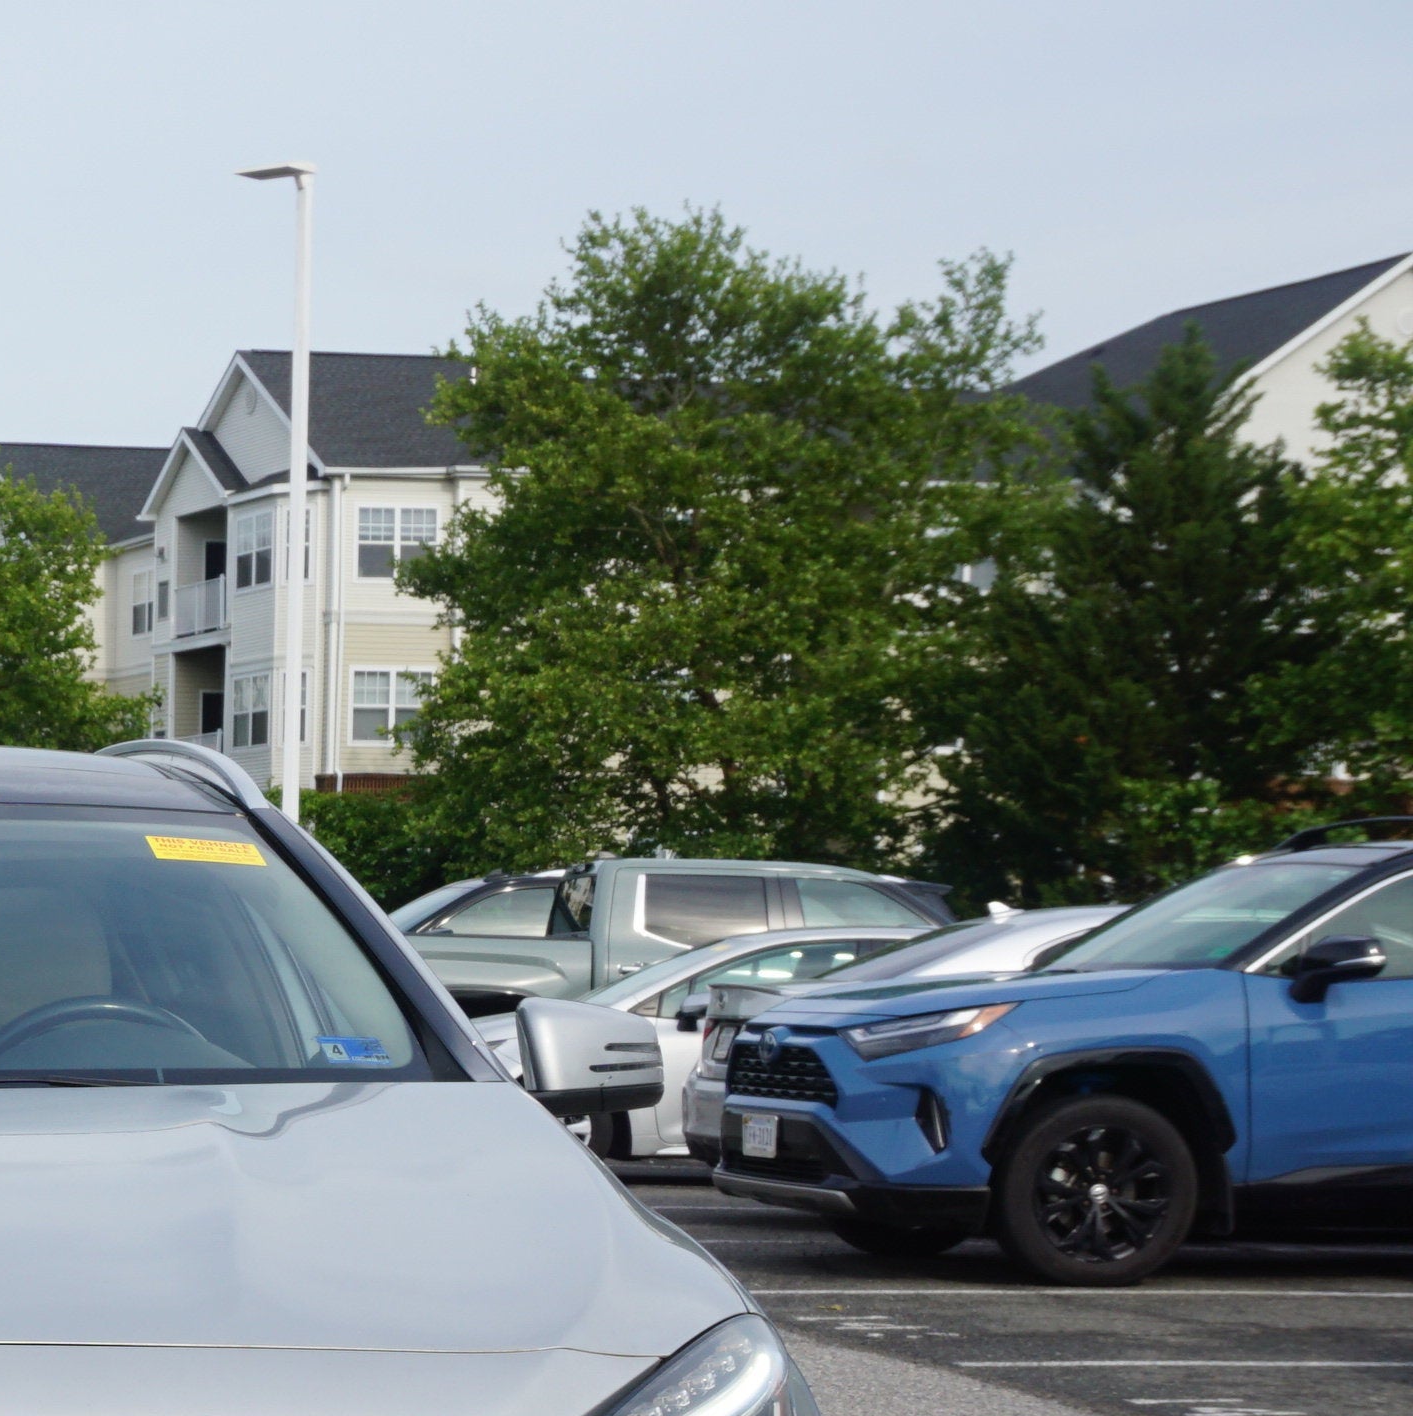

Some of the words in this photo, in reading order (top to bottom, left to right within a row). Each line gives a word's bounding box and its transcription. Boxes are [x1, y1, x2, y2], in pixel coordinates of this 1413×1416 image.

[153, 836, 185, 845] THIS
[189, 839, 251, 850] VEHICLE
[333, 1044, 343, 1056] 4
